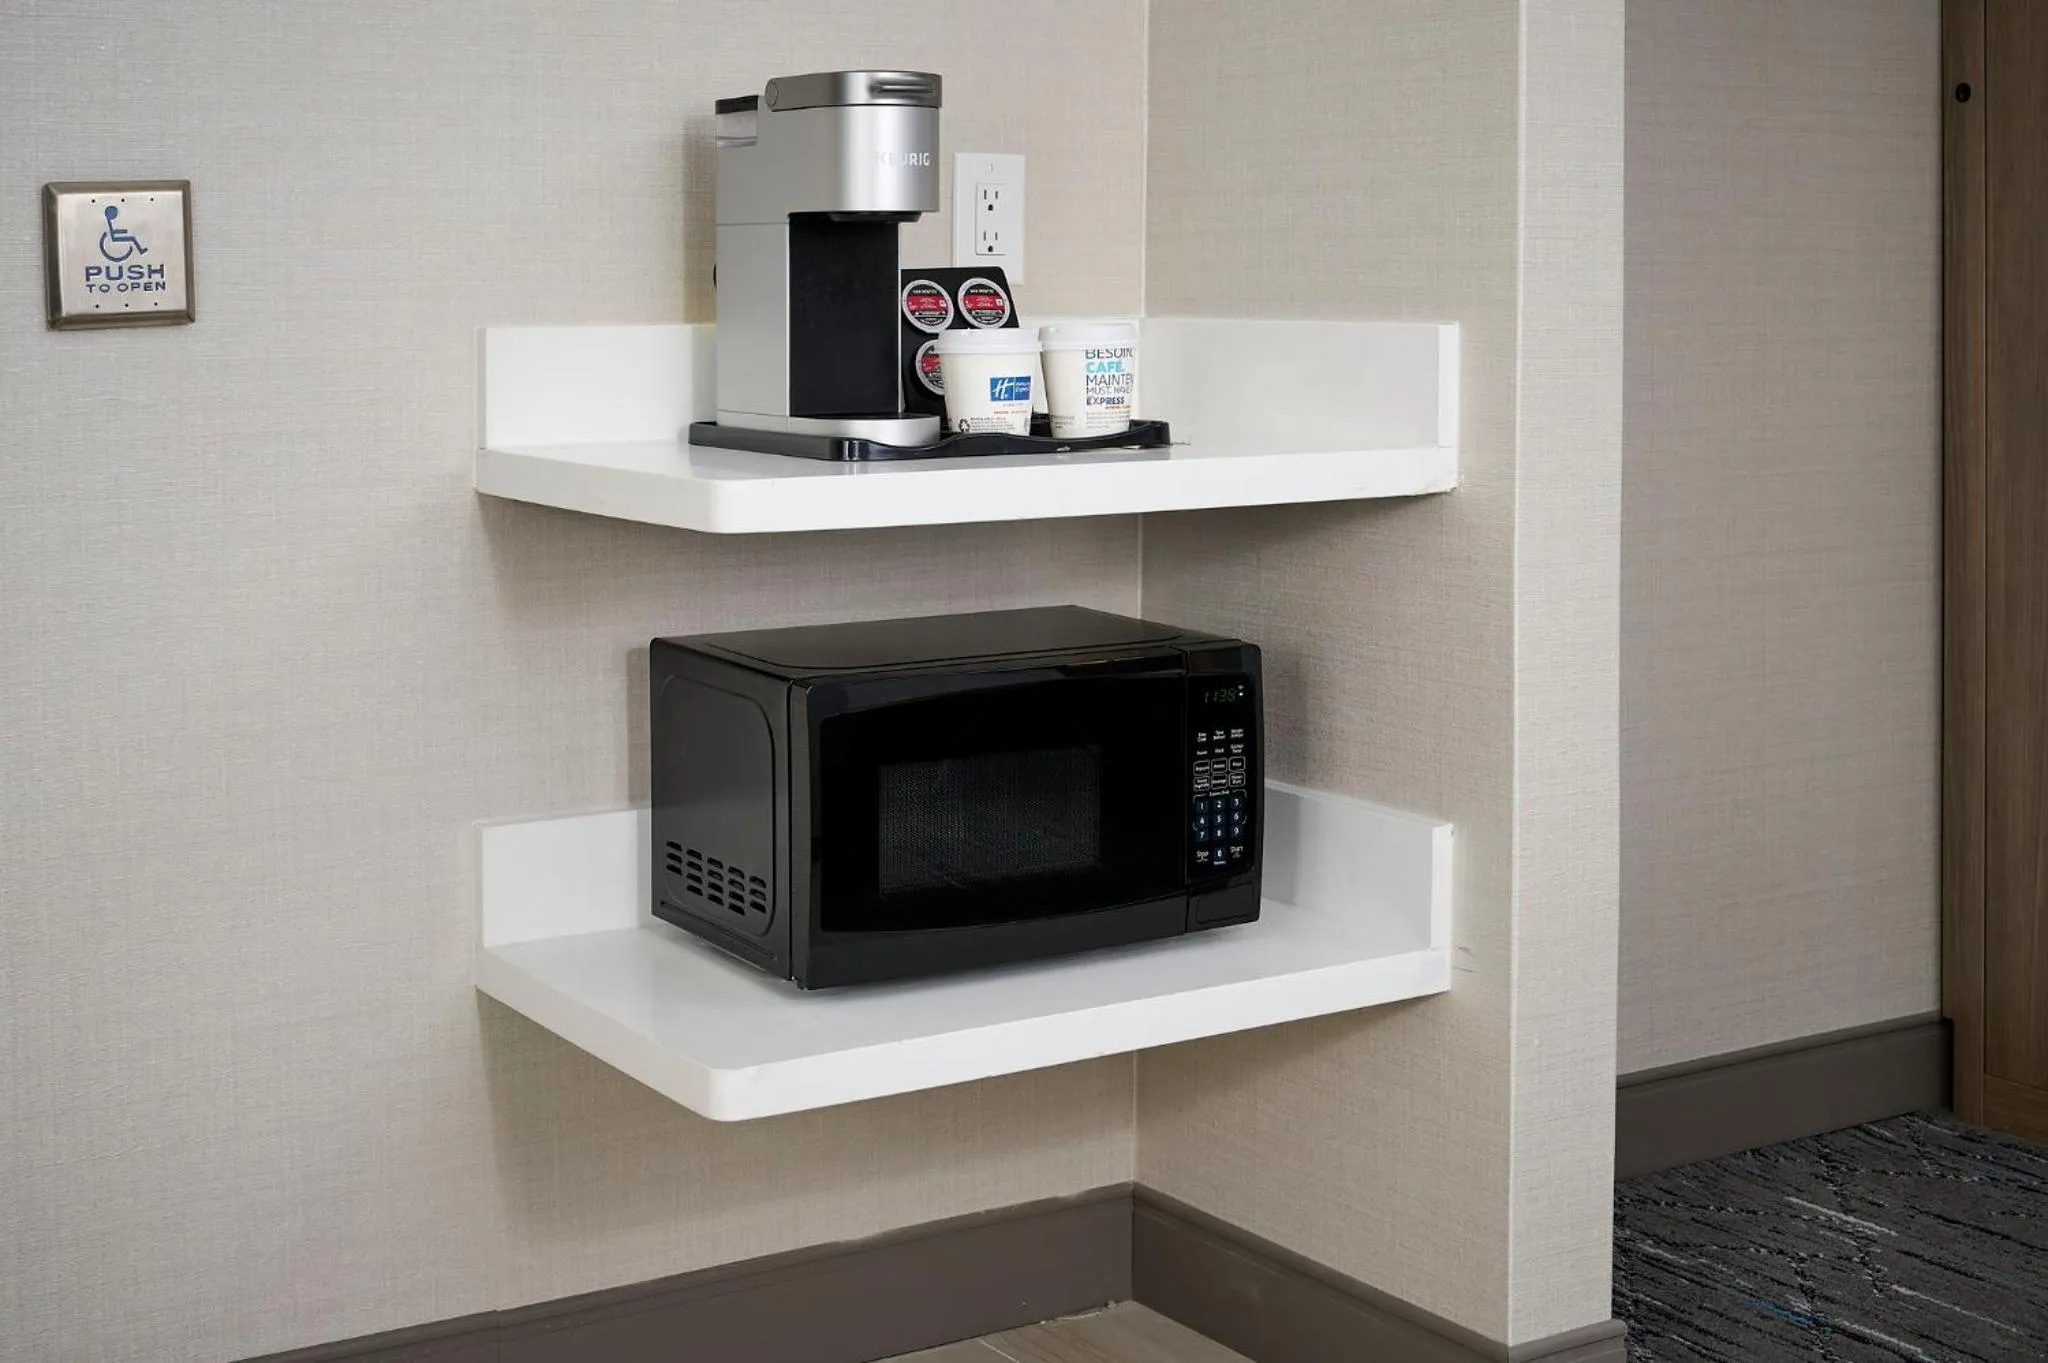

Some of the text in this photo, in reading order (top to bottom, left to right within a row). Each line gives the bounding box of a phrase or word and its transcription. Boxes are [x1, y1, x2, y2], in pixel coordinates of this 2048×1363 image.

[877, 152, 930, 166] KEURIG
[85, 264, 164, 282] PUSH
[86, 281, 166, 293] TO OPEN
[1086, 396, 1125, 406] EXPRESS
